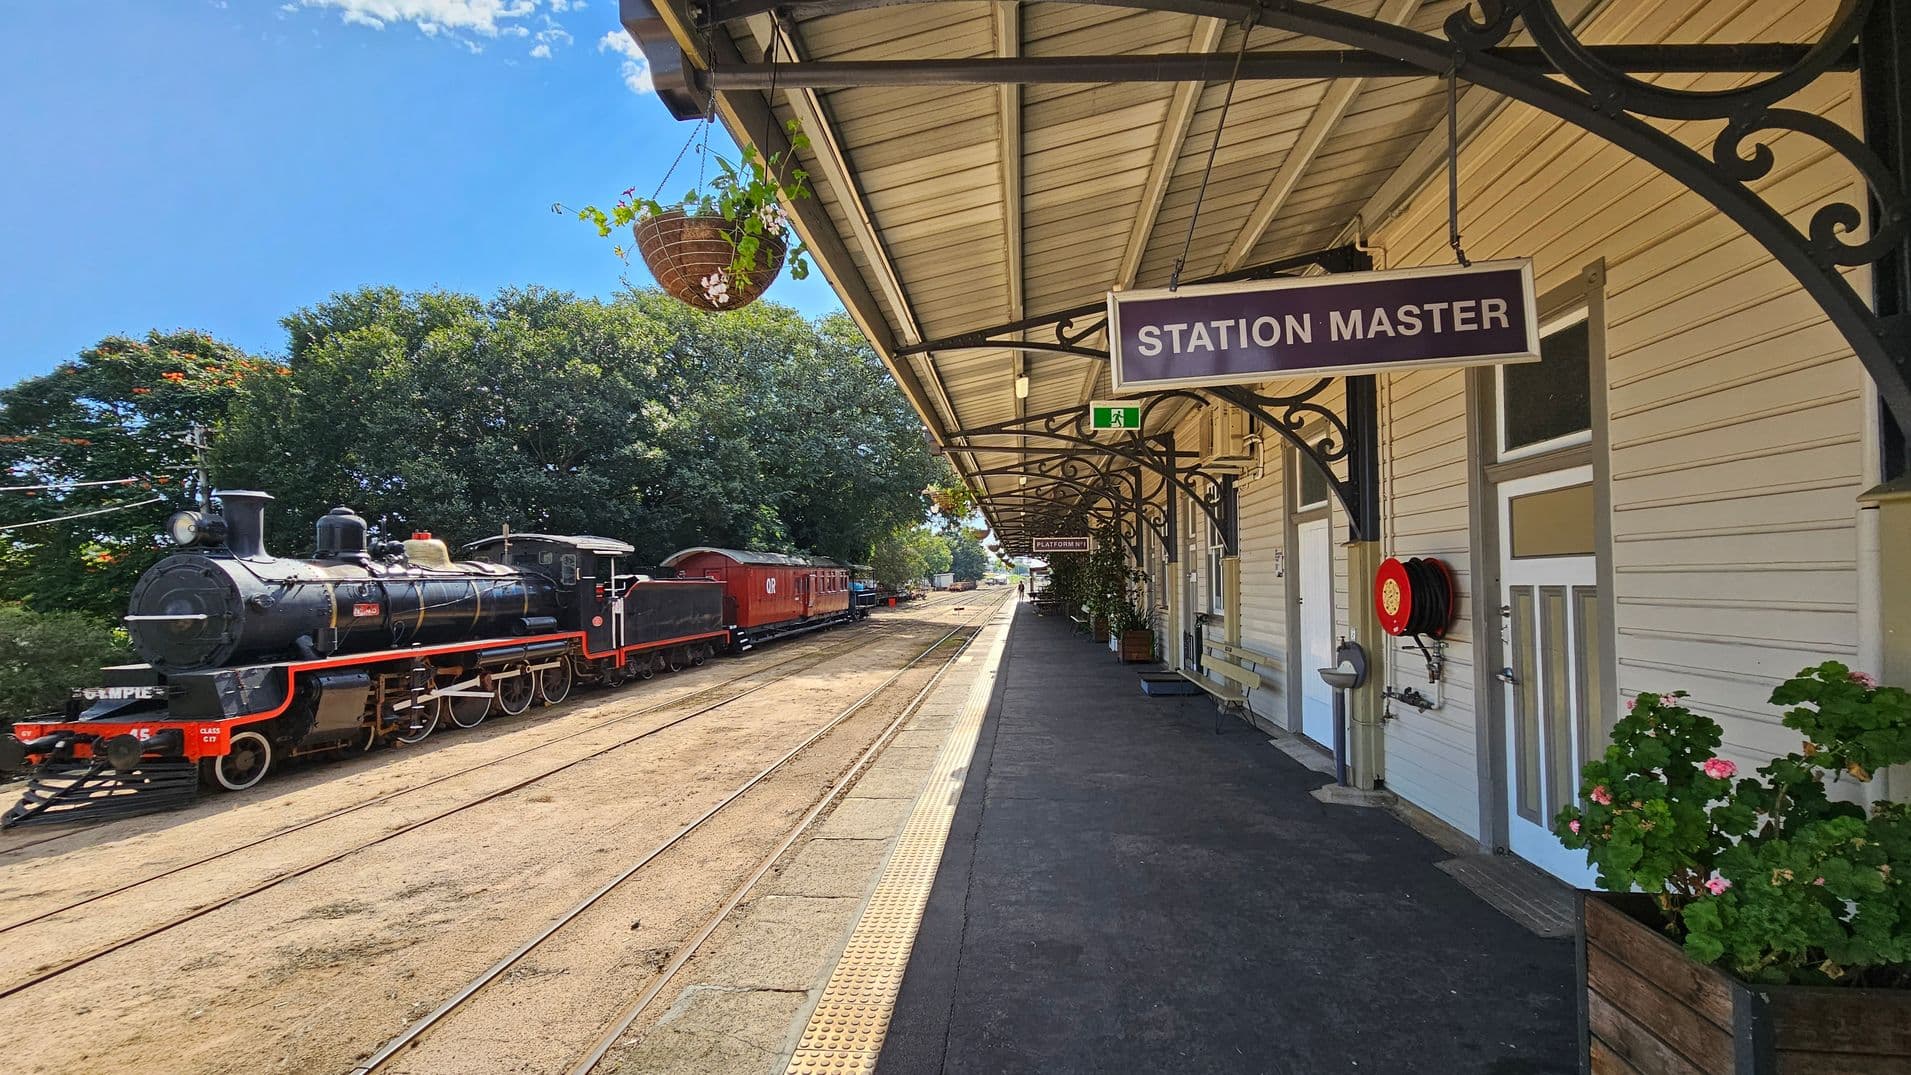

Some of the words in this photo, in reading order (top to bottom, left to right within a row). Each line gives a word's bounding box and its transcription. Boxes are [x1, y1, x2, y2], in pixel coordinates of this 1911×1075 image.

[1138, 313, 1312, 357] STATION
[1329, 298, 1510, 342] MASTER
[1036, 541, 1074, 549] PLATFORM
[766, 578, 776, 594] QR
